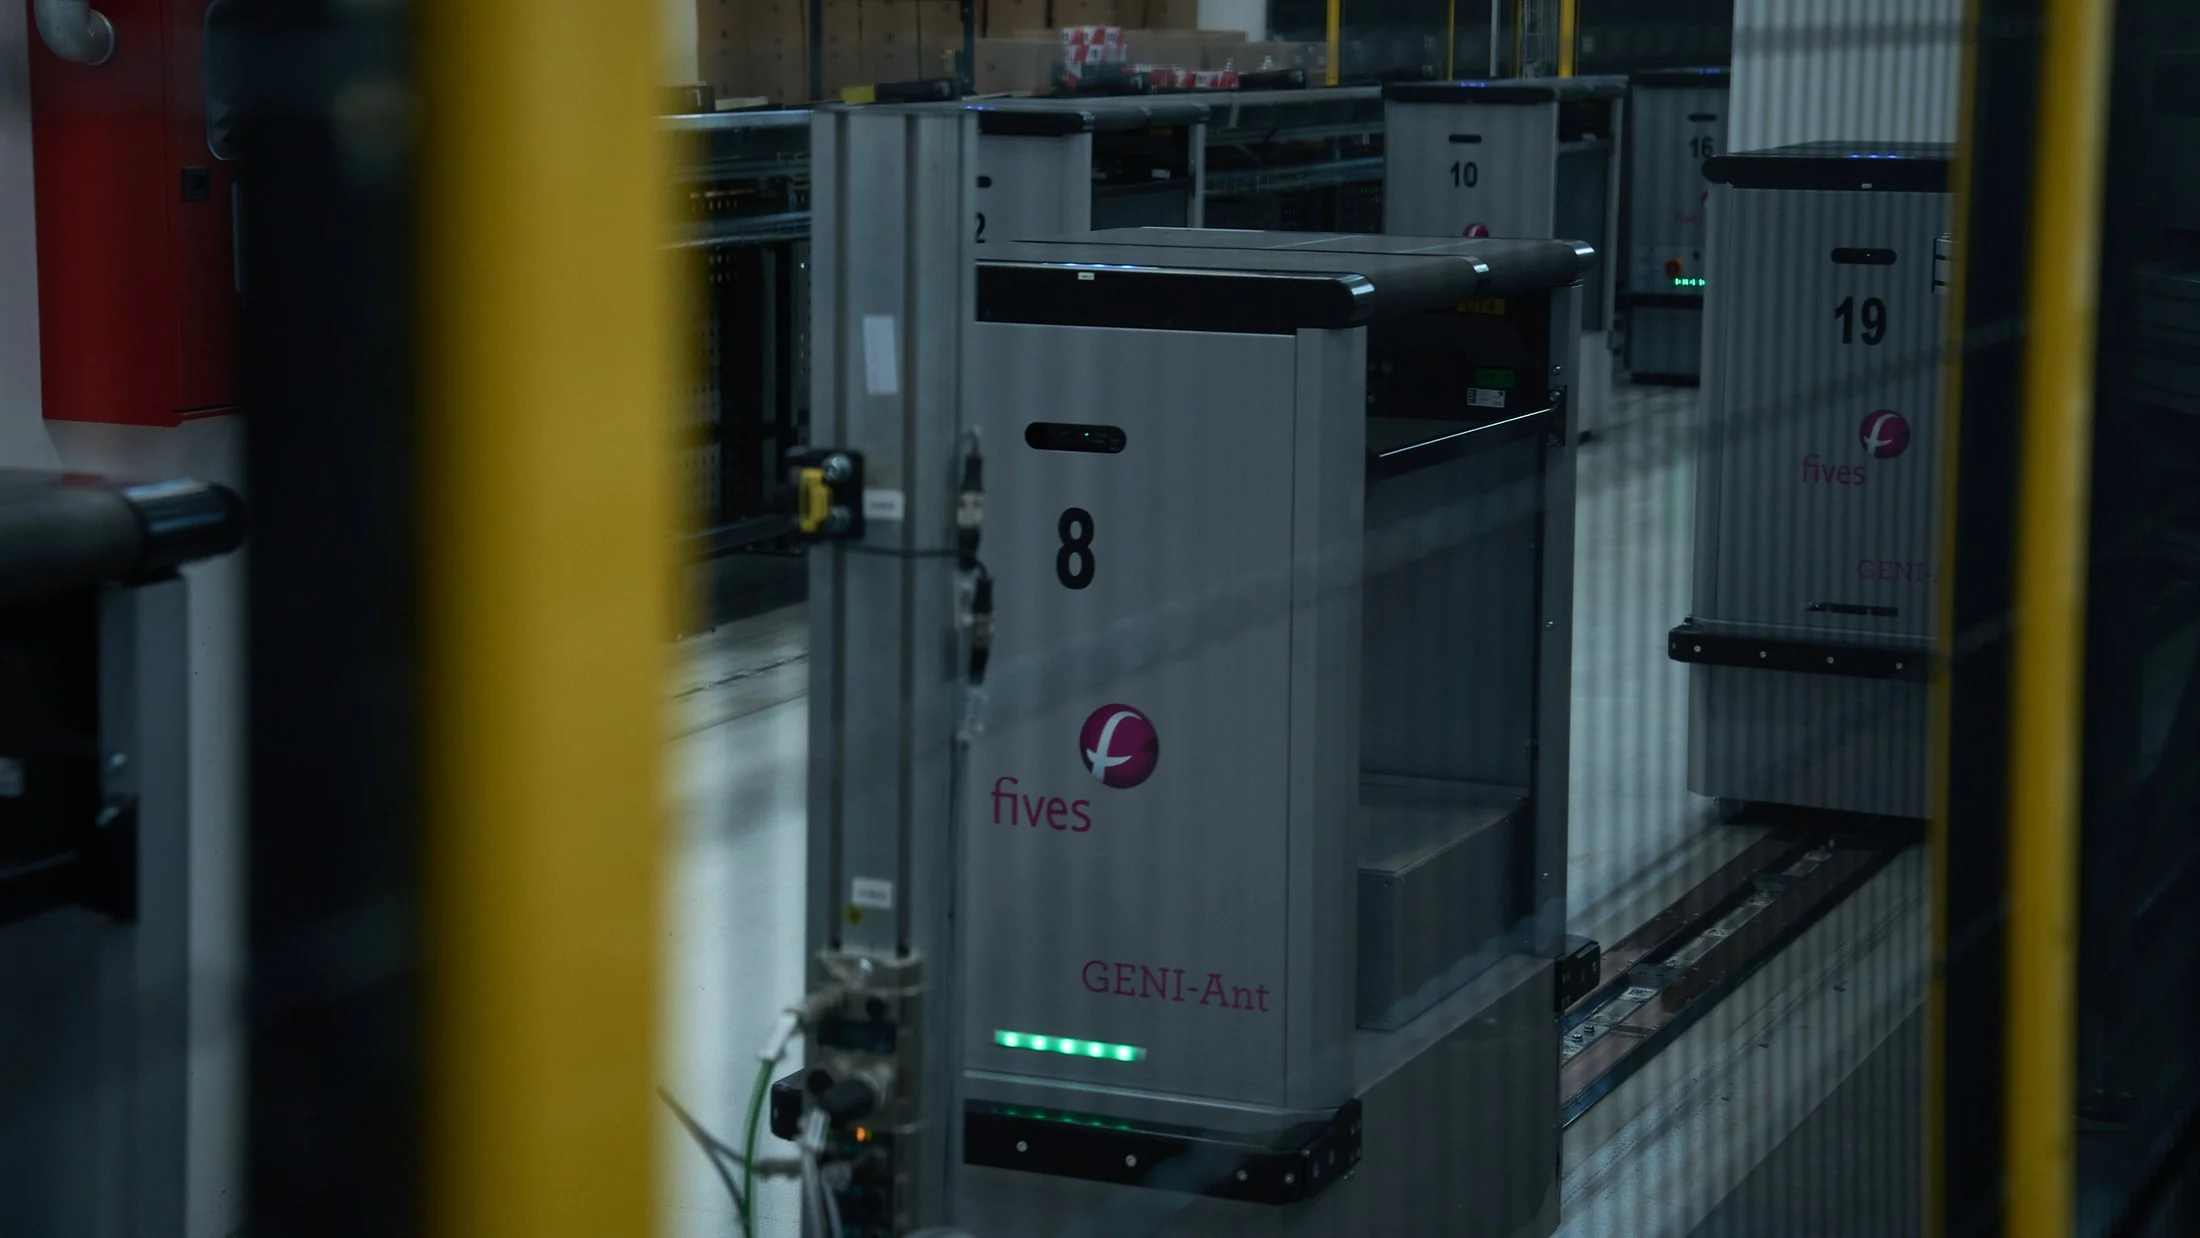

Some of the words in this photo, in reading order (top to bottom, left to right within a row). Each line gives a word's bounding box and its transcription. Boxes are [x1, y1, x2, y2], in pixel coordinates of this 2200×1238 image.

[1689, 135, 1714, 159] 16
[1450, 161, 1479, 188] 10
[1834, 295, 1888, 346] 19
[1801, 453, 1867, 486] fives
[1056, 507, 1096, 590] 8
[990, 776, 1092, 833] fives
[1081, 959, 1271, 1013] GENI-Ant
